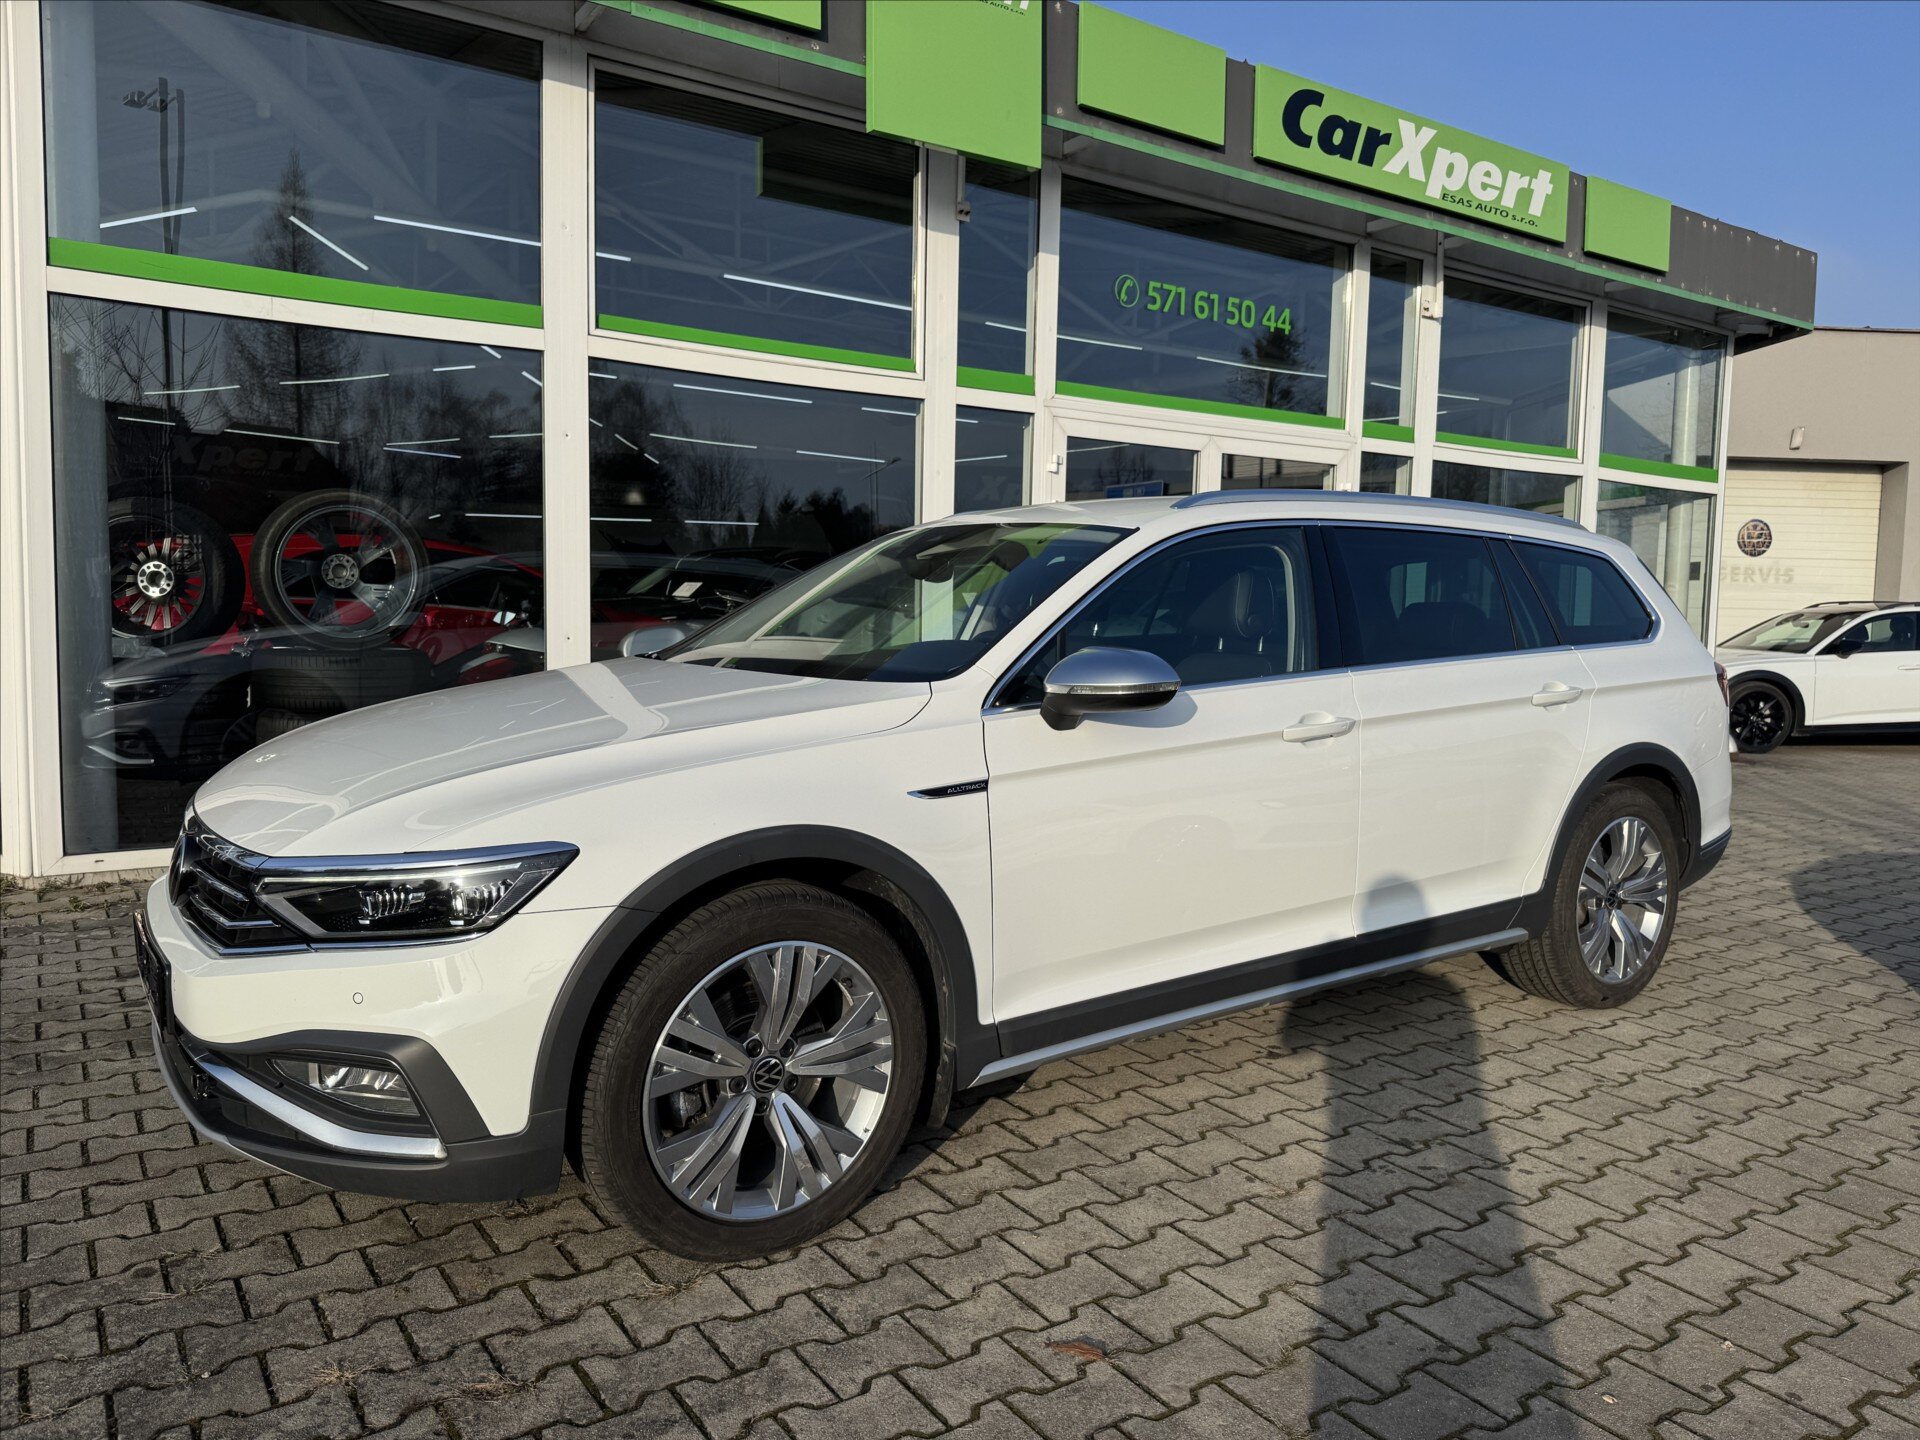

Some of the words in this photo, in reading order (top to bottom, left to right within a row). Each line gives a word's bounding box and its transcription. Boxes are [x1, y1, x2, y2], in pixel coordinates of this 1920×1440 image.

[1282, 88, 1553, 217] CarXpert
[1442, 193, 1472, 208] ESAS
[1475, 203, 1509, 218] AUTO
[1511, 214, 1538, 227] s.r.o.
[1147, 281, 1186, 316] 571
[1194, 291, 1219, 322] 61
[1226, 297, 1256, 328] 50
[1262, 305, 1291, 335] 44
[947, 782, 987, 793] ALLTRACK
